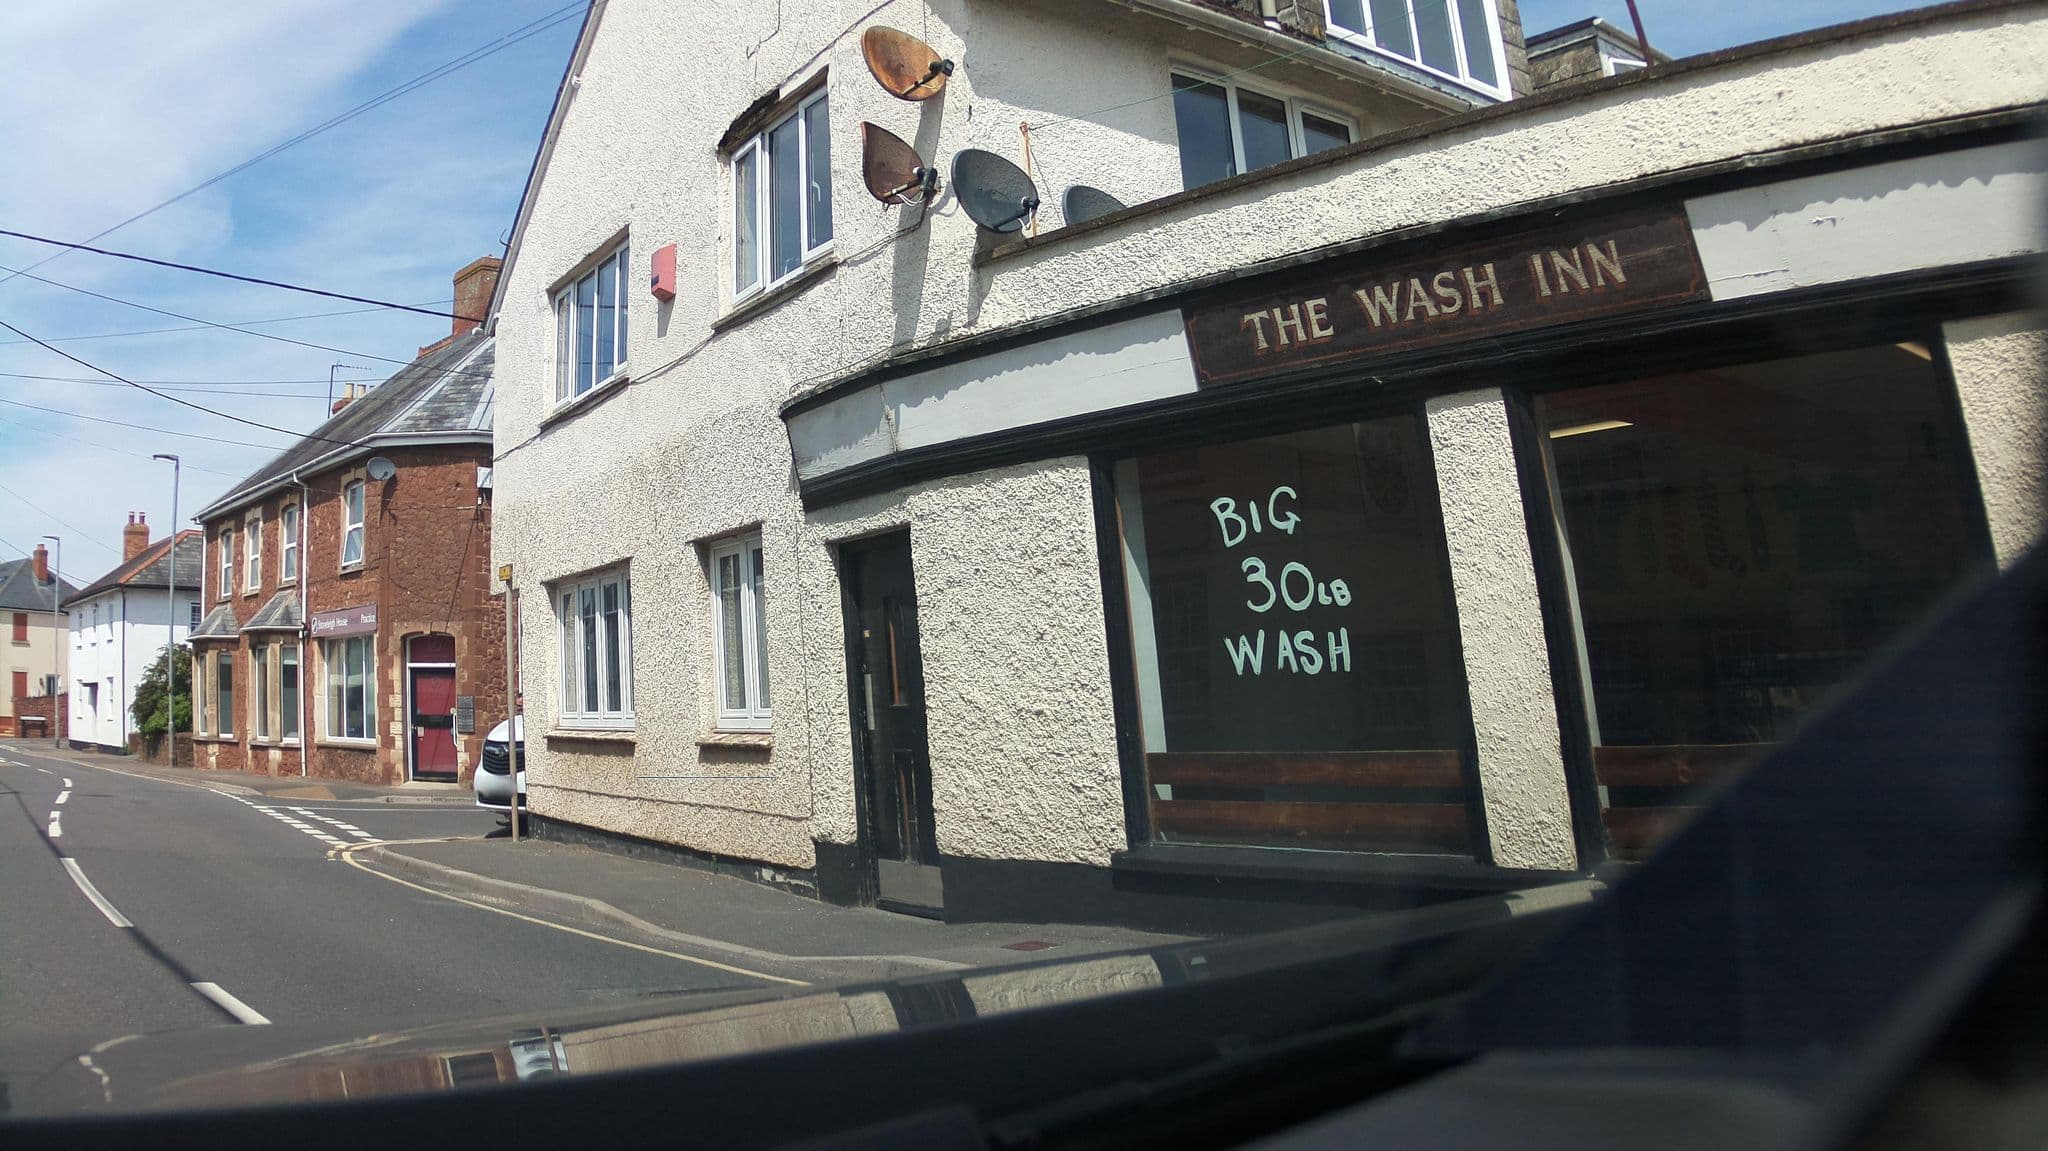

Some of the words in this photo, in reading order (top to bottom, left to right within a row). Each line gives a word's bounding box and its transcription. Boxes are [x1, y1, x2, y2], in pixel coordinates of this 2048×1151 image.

[1243, 297, 1334, 351] THE
[1354, 262, 1504, 328] WASH
[1530, 239, 1628, 297] INN
[1210, 486, 1301, 548] BIG
[336, 617, 348, 626] House
[1224, 627, 1351, 676] WASH
